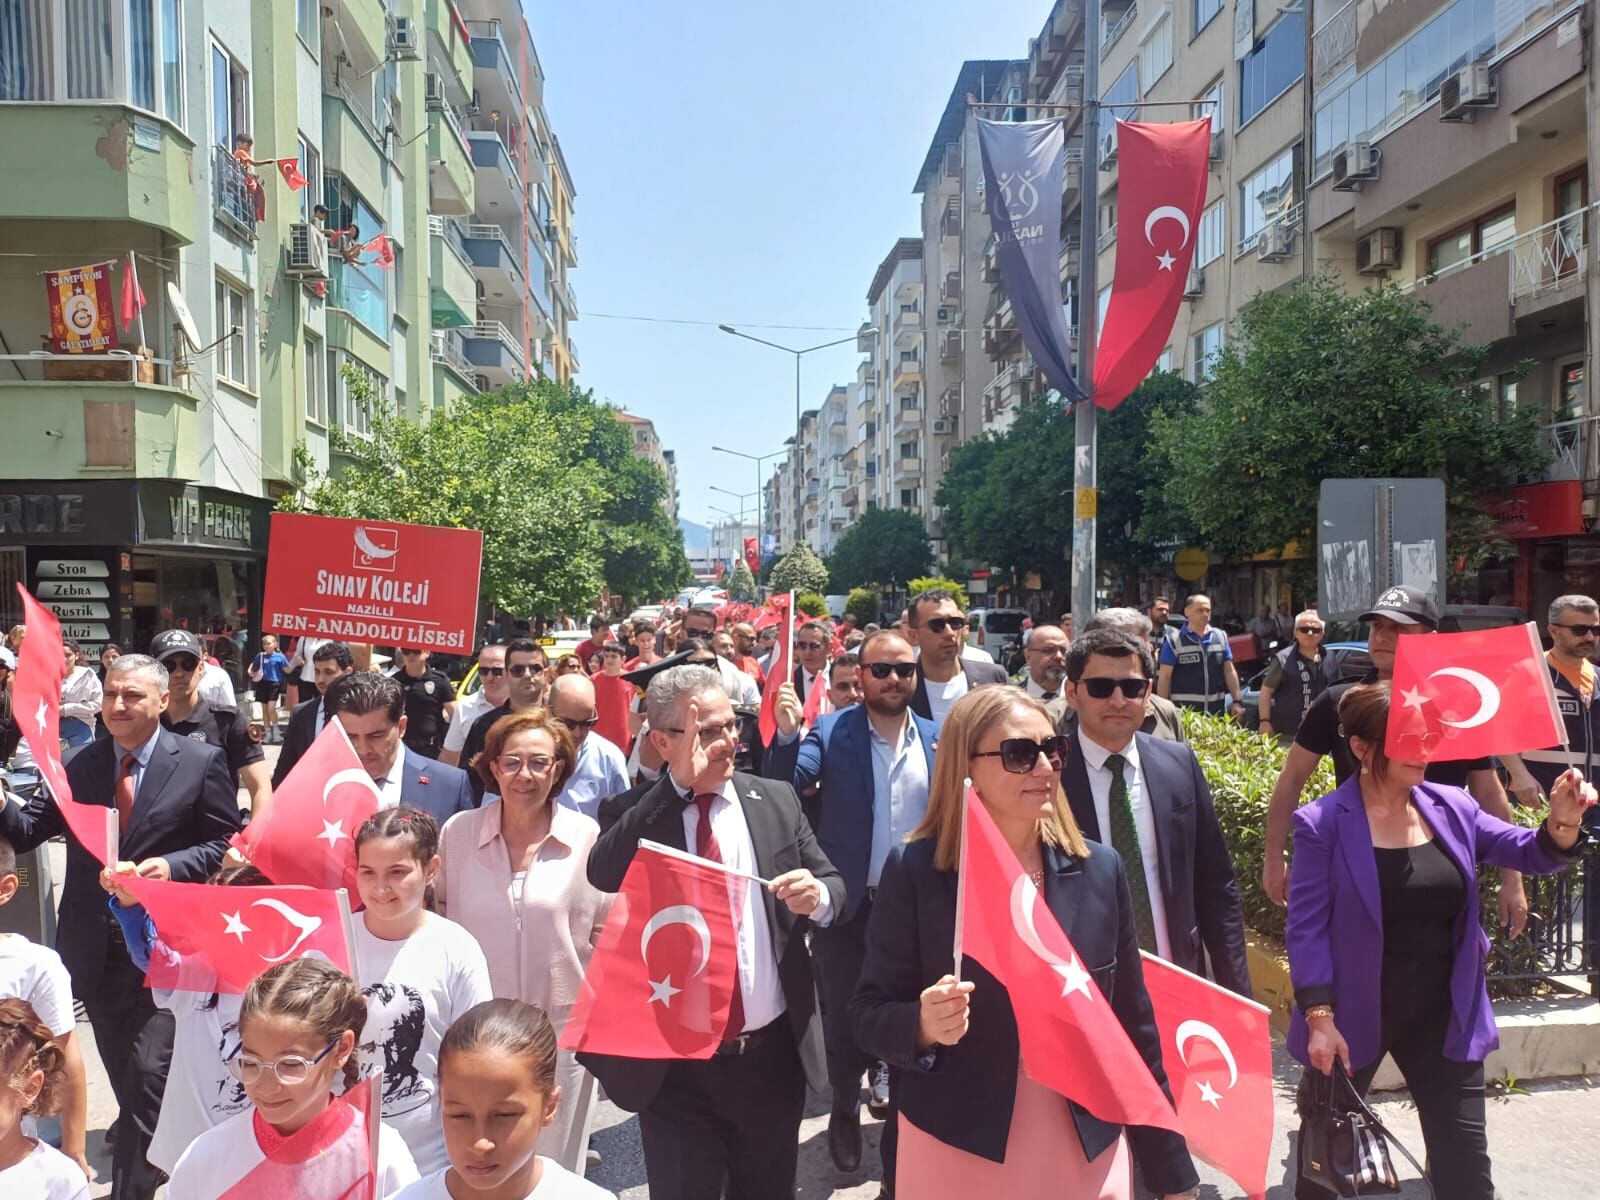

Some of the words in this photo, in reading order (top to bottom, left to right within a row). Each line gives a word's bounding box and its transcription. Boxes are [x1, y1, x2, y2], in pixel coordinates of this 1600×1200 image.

[51, 269, 103, 287] ŞAMPİYON
[347, 603, 394, 617] NAZİLLİ
[271, 613, 403, 641] FEN-ANADOLU
[407, 625, 465, 648] LİSESİ
